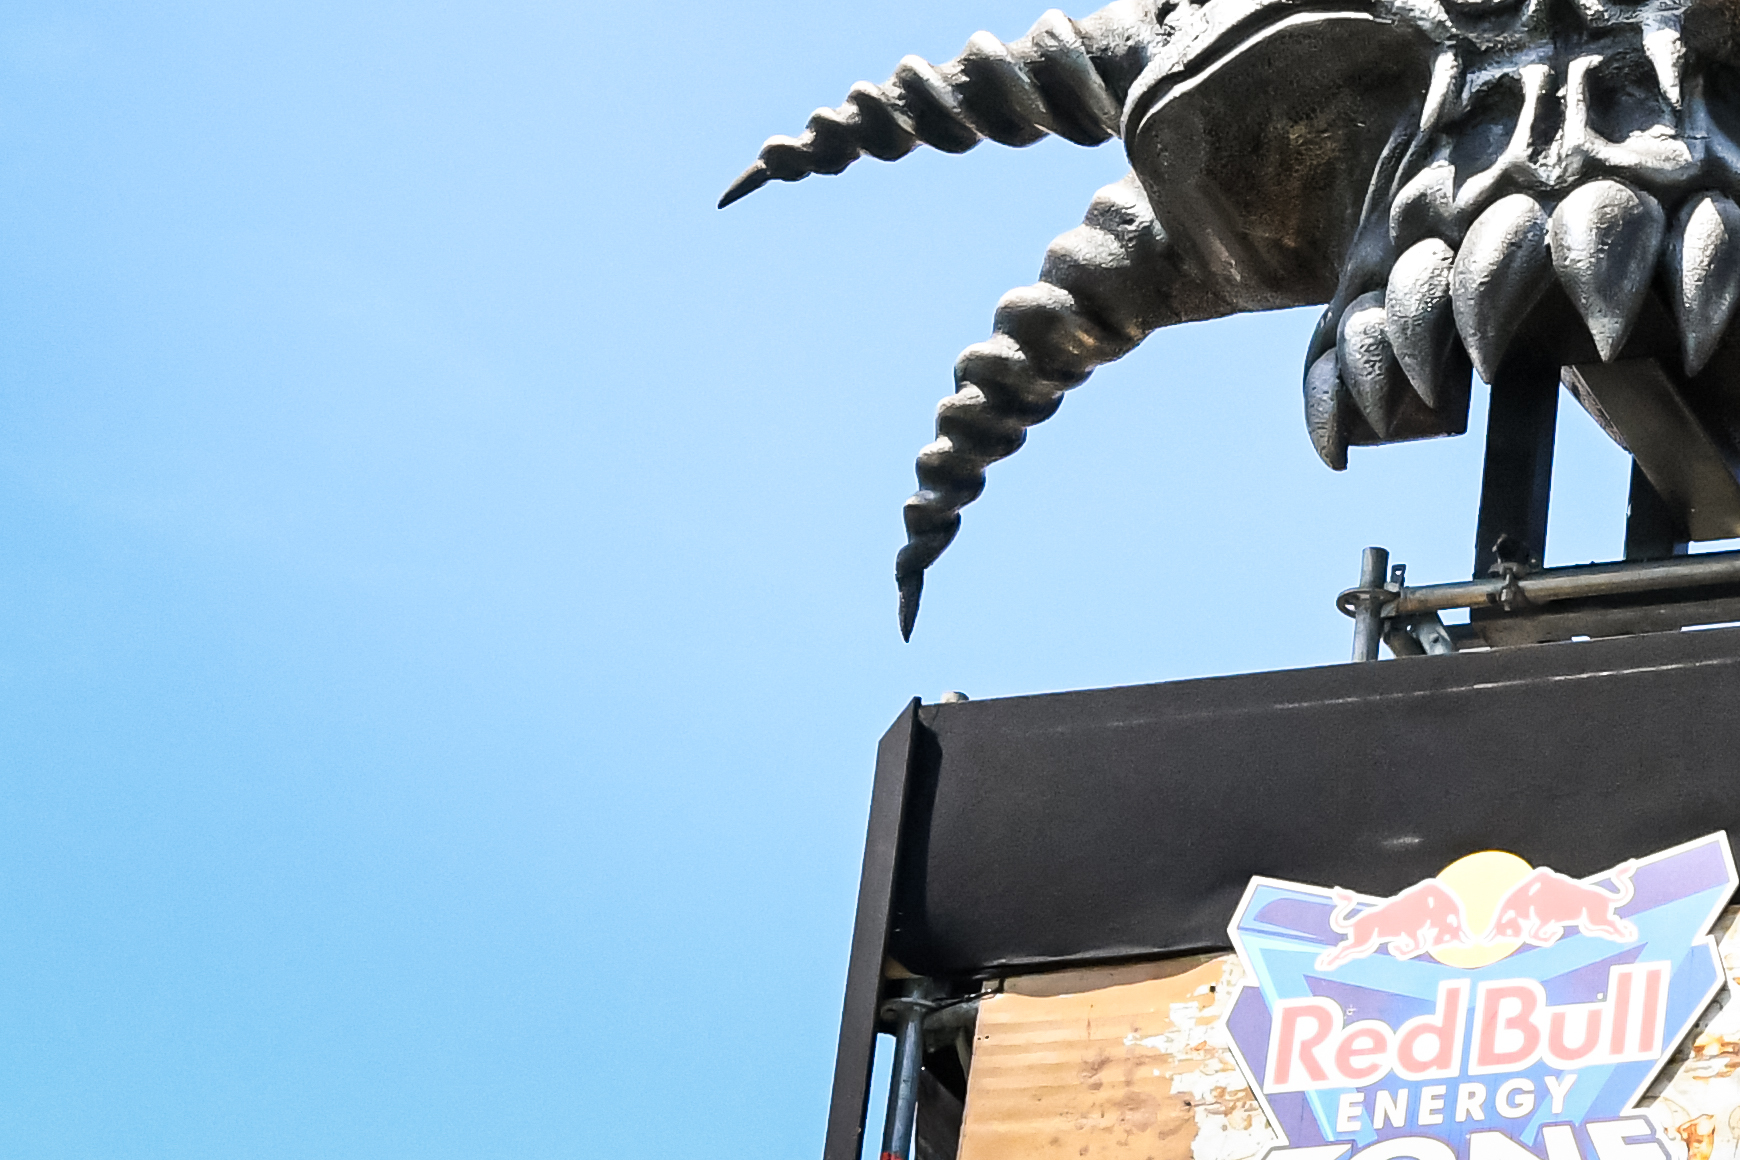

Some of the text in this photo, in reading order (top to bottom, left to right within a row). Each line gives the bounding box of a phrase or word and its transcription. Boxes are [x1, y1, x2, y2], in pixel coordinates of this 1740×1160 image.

[1272, 969, 1663, 1086] Red Bull
[1336, 1075, 1577, 1132] ENERGY
